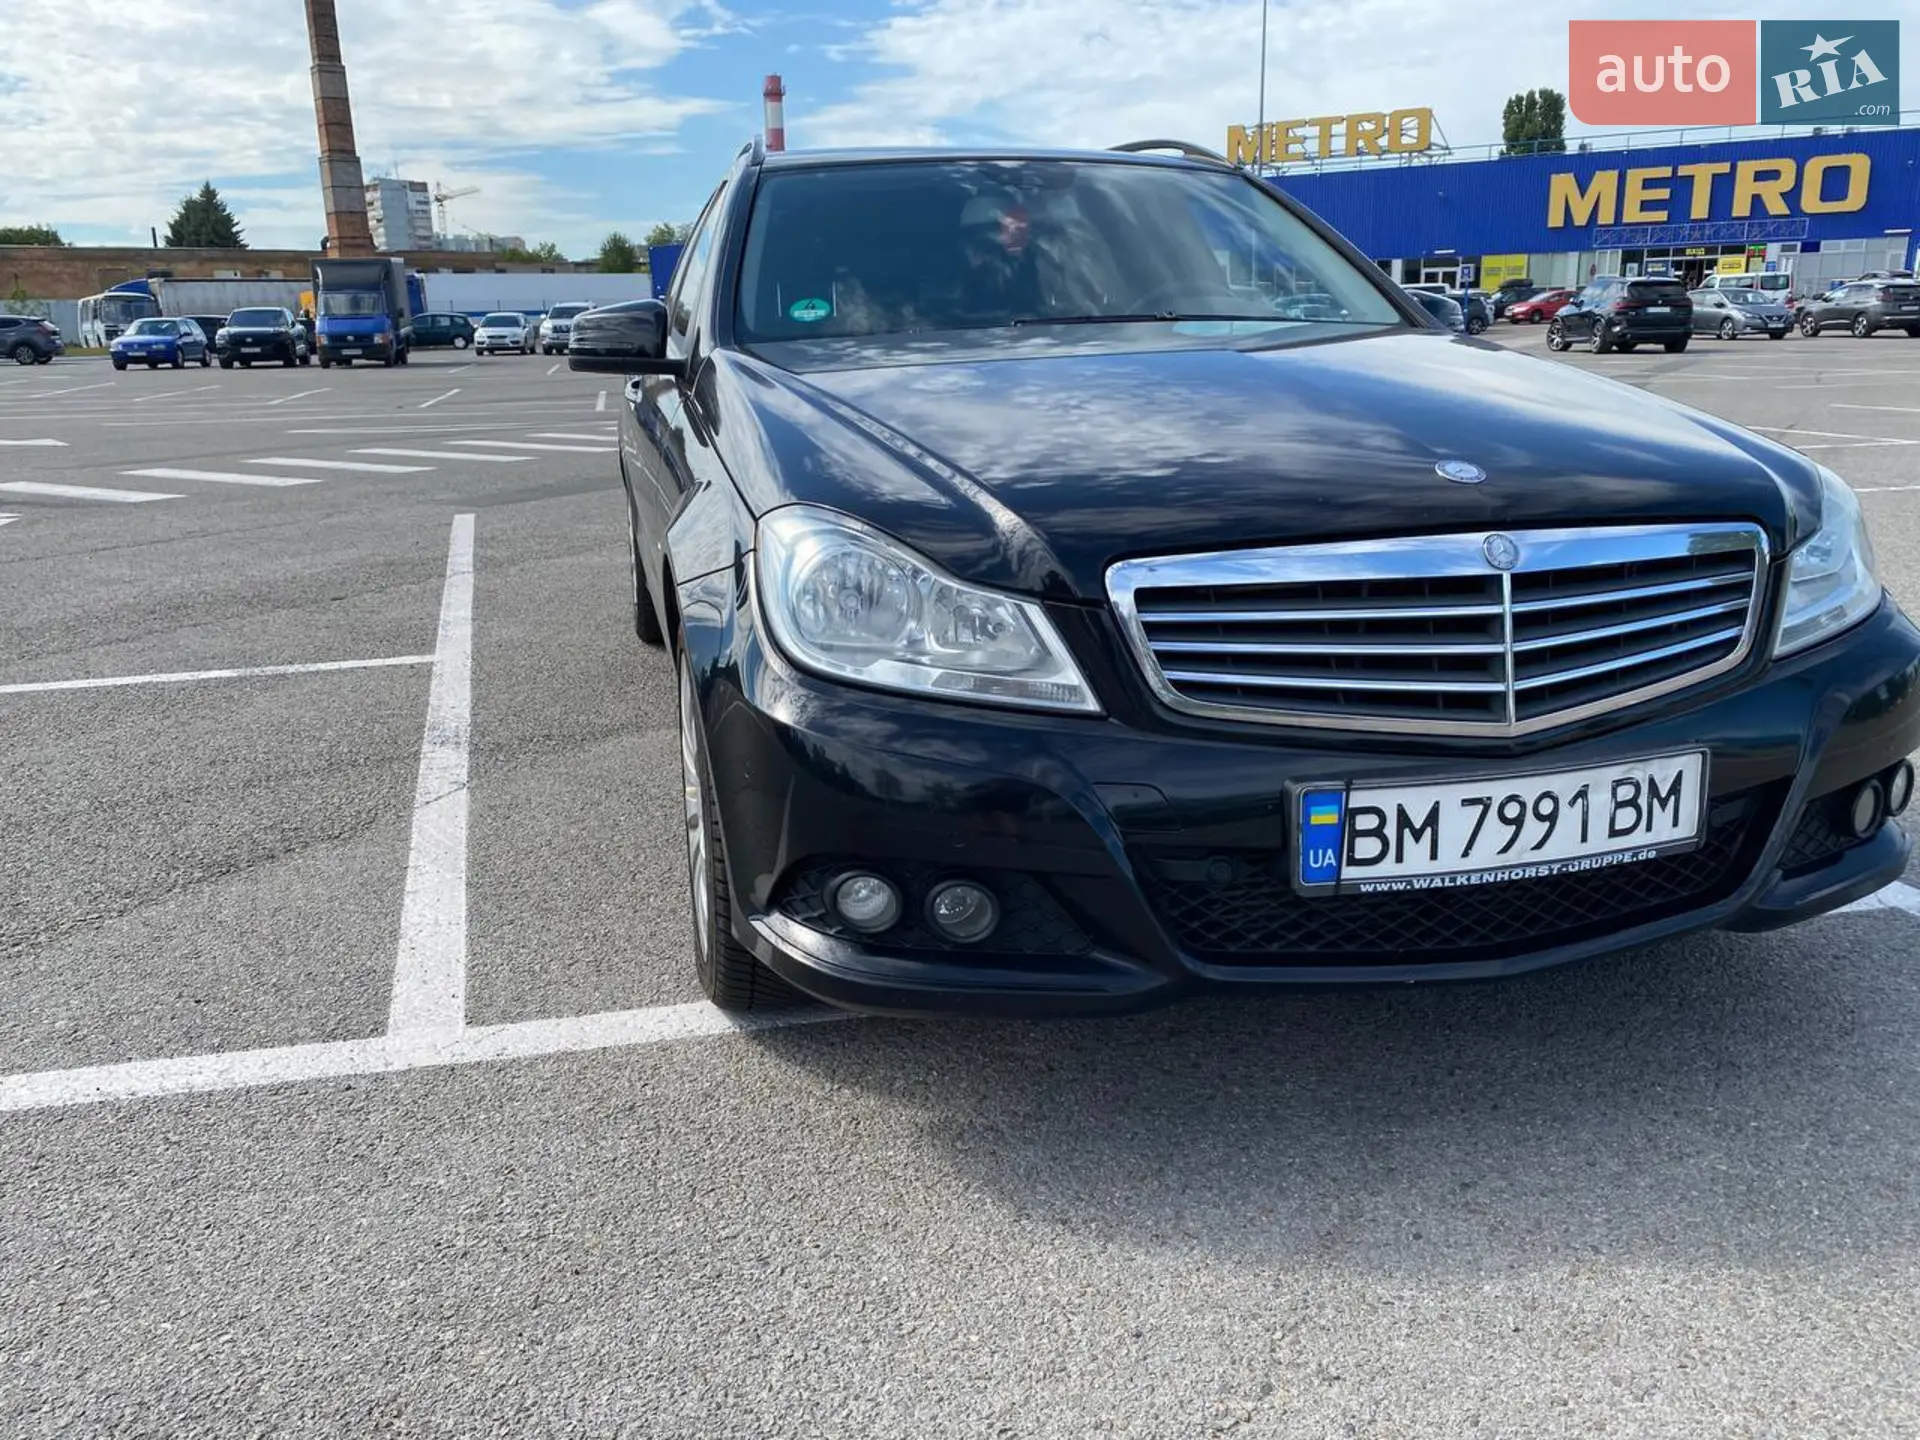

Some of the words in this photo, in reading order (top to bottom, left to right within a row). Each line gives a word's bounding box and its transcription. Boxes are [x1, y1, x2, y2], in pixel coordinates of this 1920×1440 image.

[1227, 108, 1432, 164] METRO
[1547, 153, 1871, 228] METRO
[1345, 800, 1438, 867] BM
[1460, 783, 1589, 858] 7991
[1607, 769, 1684, 838] BM
[1310, 848, 1336, 868] UA
[1360, 850, 1656, 892] www.WALKENHORST-GRUPPE.de
